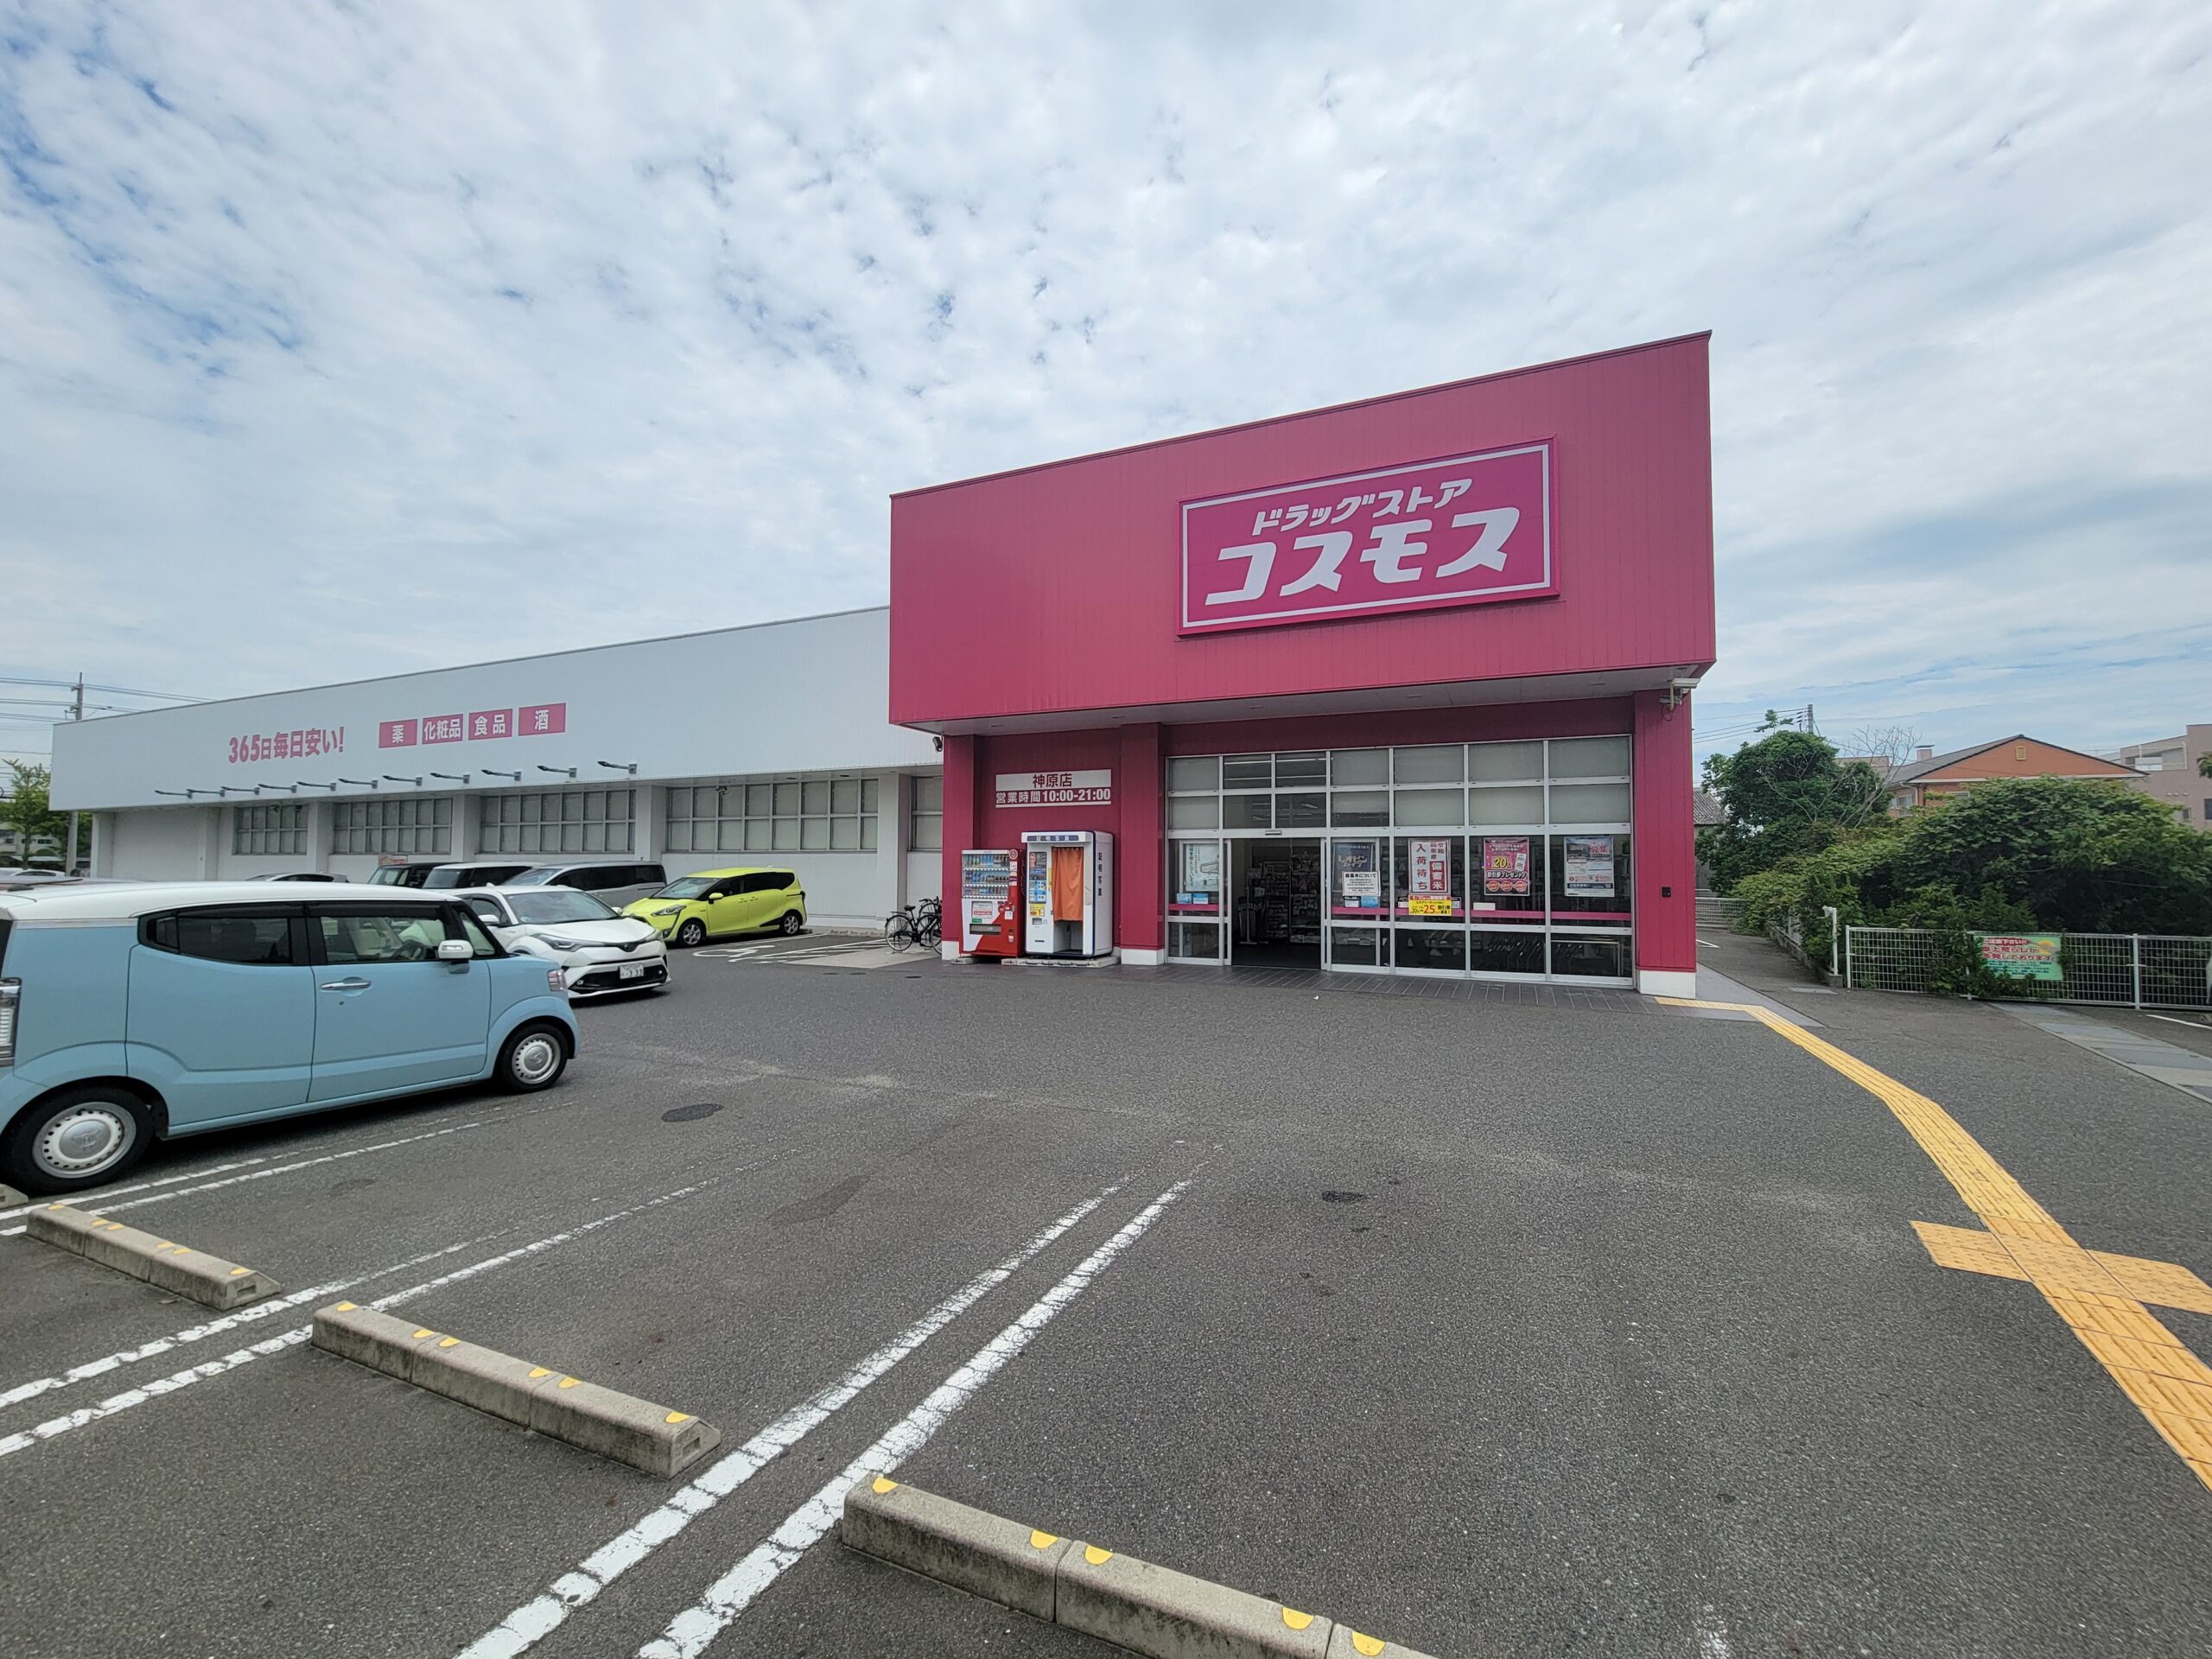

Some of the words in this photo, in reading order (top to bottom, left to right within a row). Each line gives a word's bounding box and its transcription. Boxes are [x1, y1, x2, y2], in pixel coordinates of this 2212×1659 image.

[1251, 478, 1473, 537] ドラッグストア
[1205, 506, 1521, 607] コスモス
[228, 726, 345, 764] 365日毎日安い!
[391, 725, 405, 745] 薬
[423, 718, 462, 741] 化粧品
[474, 715, 506, 737] 食品
[534, 710, 550, 731] 酒
[1033, 773, 1072, 788] 神原店
[1416, 843, 1427, 891] 入荷待ち
